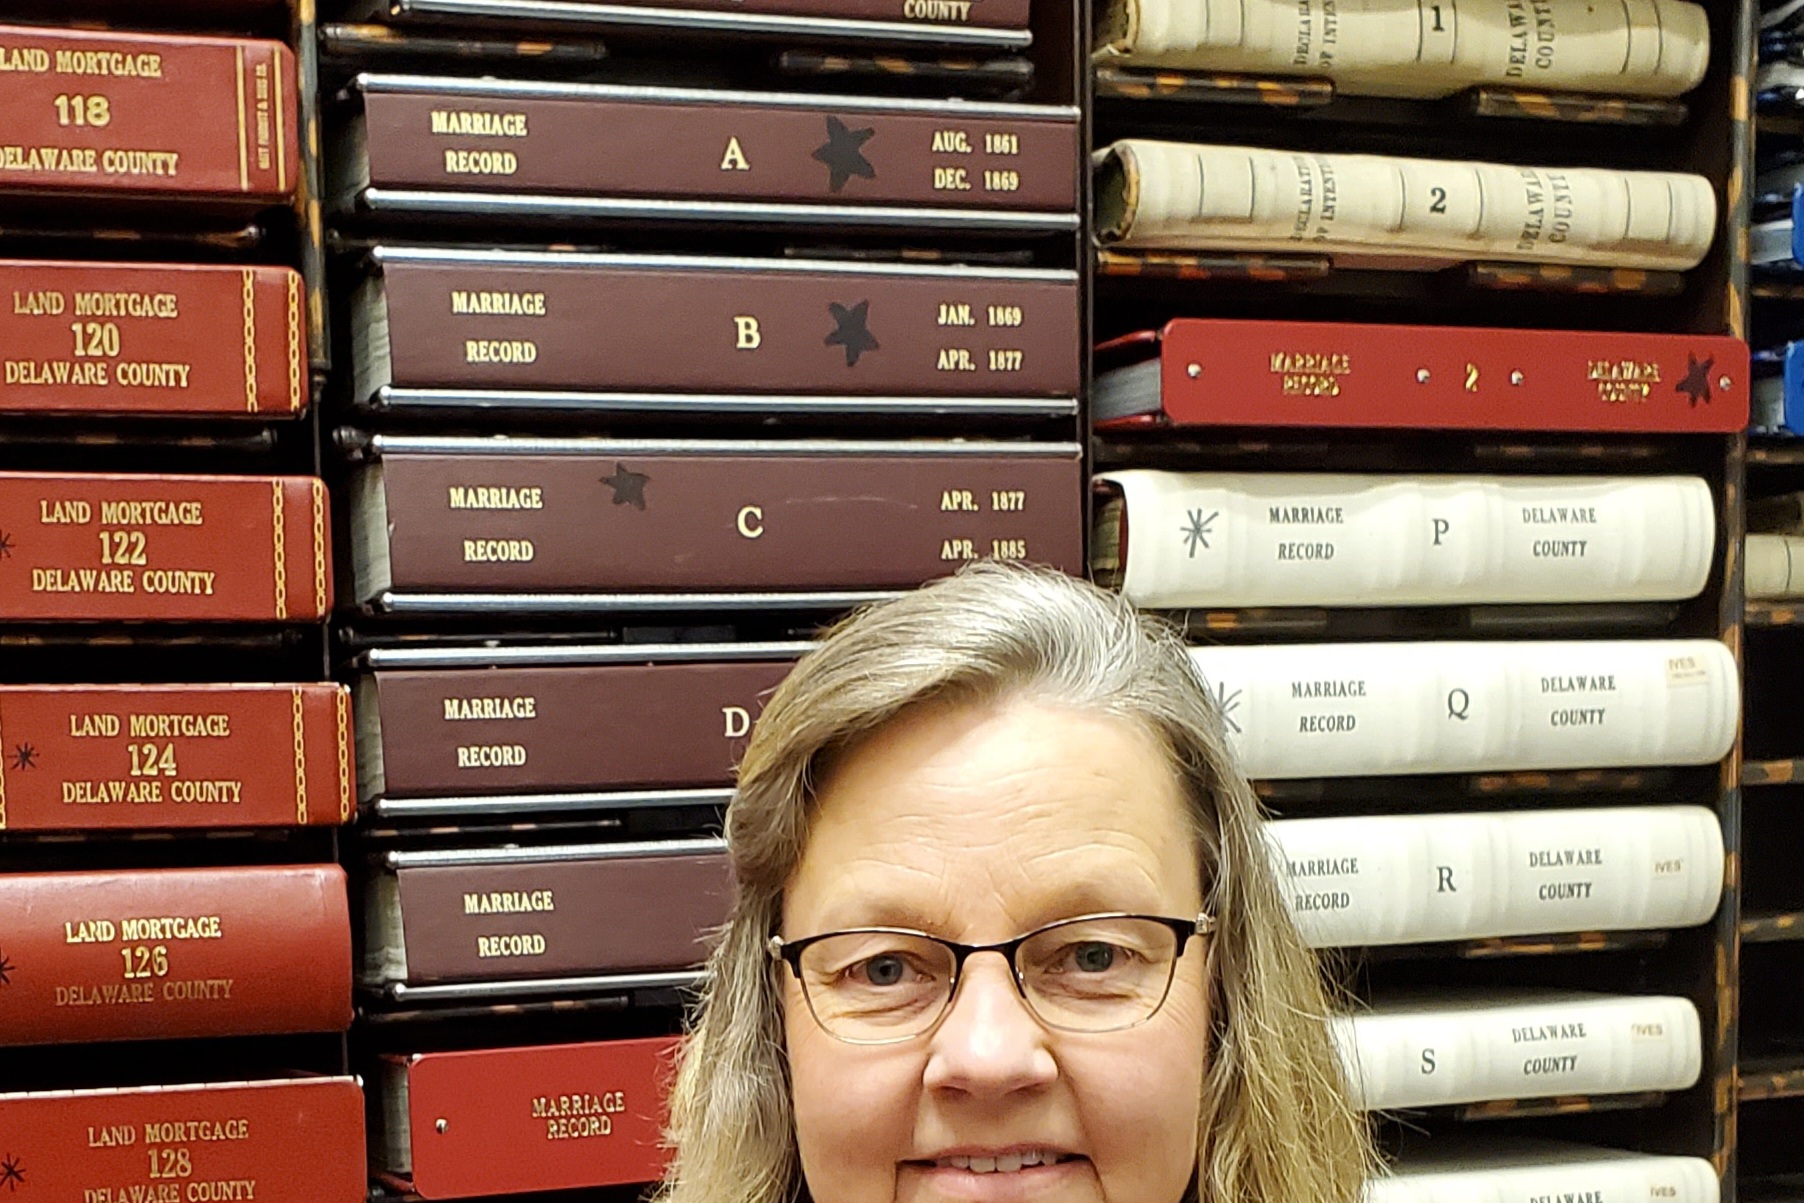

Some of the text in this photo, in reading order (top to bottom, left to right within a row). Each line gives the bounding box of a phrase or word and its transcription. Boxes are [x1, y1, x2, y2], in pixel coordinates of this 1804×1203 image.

[904, 0, 972, 22] COUNTY
[1431, 6, 1445, 32] 1
[0, 47, 162, 77] LAND MORTGAGE
[54, 94, 110, 126] 118
[431, 111, 528, 137] MARRIAGE
[720, 136, 750, 171] A
[931, 131, 1019, 155] AUG. 1861
[103, 152, 178, 176] COUNTY
[445, 150, 517, 175] RECORD
[933, 168, 1019, 191] DEC. 1869
[1430, 188, 1446, 214] 2
[14, 292, 178, 317] LAND MORTGAGE
[452, 291, 546, 315] MARRIAGE
[937, 304, 1022, 327] JAN. 1869
[72, 323, 119, 356] 120
[733, 316, 761, 349] B
[466, 340, 537, 363] RECORD
[937, 349, 1023, 371] APR. 1877
[6, 362, 190, 387] DELAWARE COUNTY
[449, 487, 543, 510] MARRIAGE
[941, 490, 1025, 511] APR. 1877
[41, 501, 202, 525] LAND MORTGAGE
[737, 506, 764, 538] C
[1269, 507, 1344, 525] MARRIAGE
[1522, 507, 1597, 524] DELAWARE
[1432, 518, 1450, 546] P
[99, 532, 147, 565] 122
[463, 540, 534, 562] RECORD
[941, 539, 1026, 560] APR. 1885
[1278, 543, 1335, 561] RECORD
[1533, 540, 1588, 558] COUNTY
[33, 569, 215, 594] DELAWARE COUNTY
[1291, 680, 1367, 699] MARRIAGE
[1541, 675, 1617, 693] DELAWARE
[444, 697, 536, 720] MARRIAGE
[1447, 688, 1470, 721] Q
[70, 715, 230, 737] LAND MORTGAGE
[721, 706, 751, 738] D
[1299, 715, 1356, 733] RECORD
[1550, 708, 1606, 726] COUNTY
[128, 743, 177, 776] 124
[457, 745, 526, 767] RECORD
[62, 781, 242, 803] DELAWARE COUNTY
[1529, 849, 1603, 868] DELAWARE
[1437, 866, 1457, 893] R
[1538, 882, 1592, 901] COUNTY
[463, 891, 554, 914] MARRIAGE
[1295, 892, 1350, 912] RECORD
[65, 917, 222, 943] LAND MORTGAGE
[477, 935, 546, 957] RECORD
[121, 946, 169, 978] 126
[56, 980, 234, 1006] DELAWARE COUNTY
[1512, 1023, 1587, 1044] DELAWARE
[1421, 1048, 1436, 1075] S
[1523, 1056, 1578, 1076] COUNTY
[531, 1091, 626, 1119] MARRIAGE
[88, 1119, 249, 1147] LAND MORTGAGE
[547, 1115, 612, 1140] RECORD
[148, 1149, 192, 1179] 128
[188, 1180, 256, 1203] COUNTY
